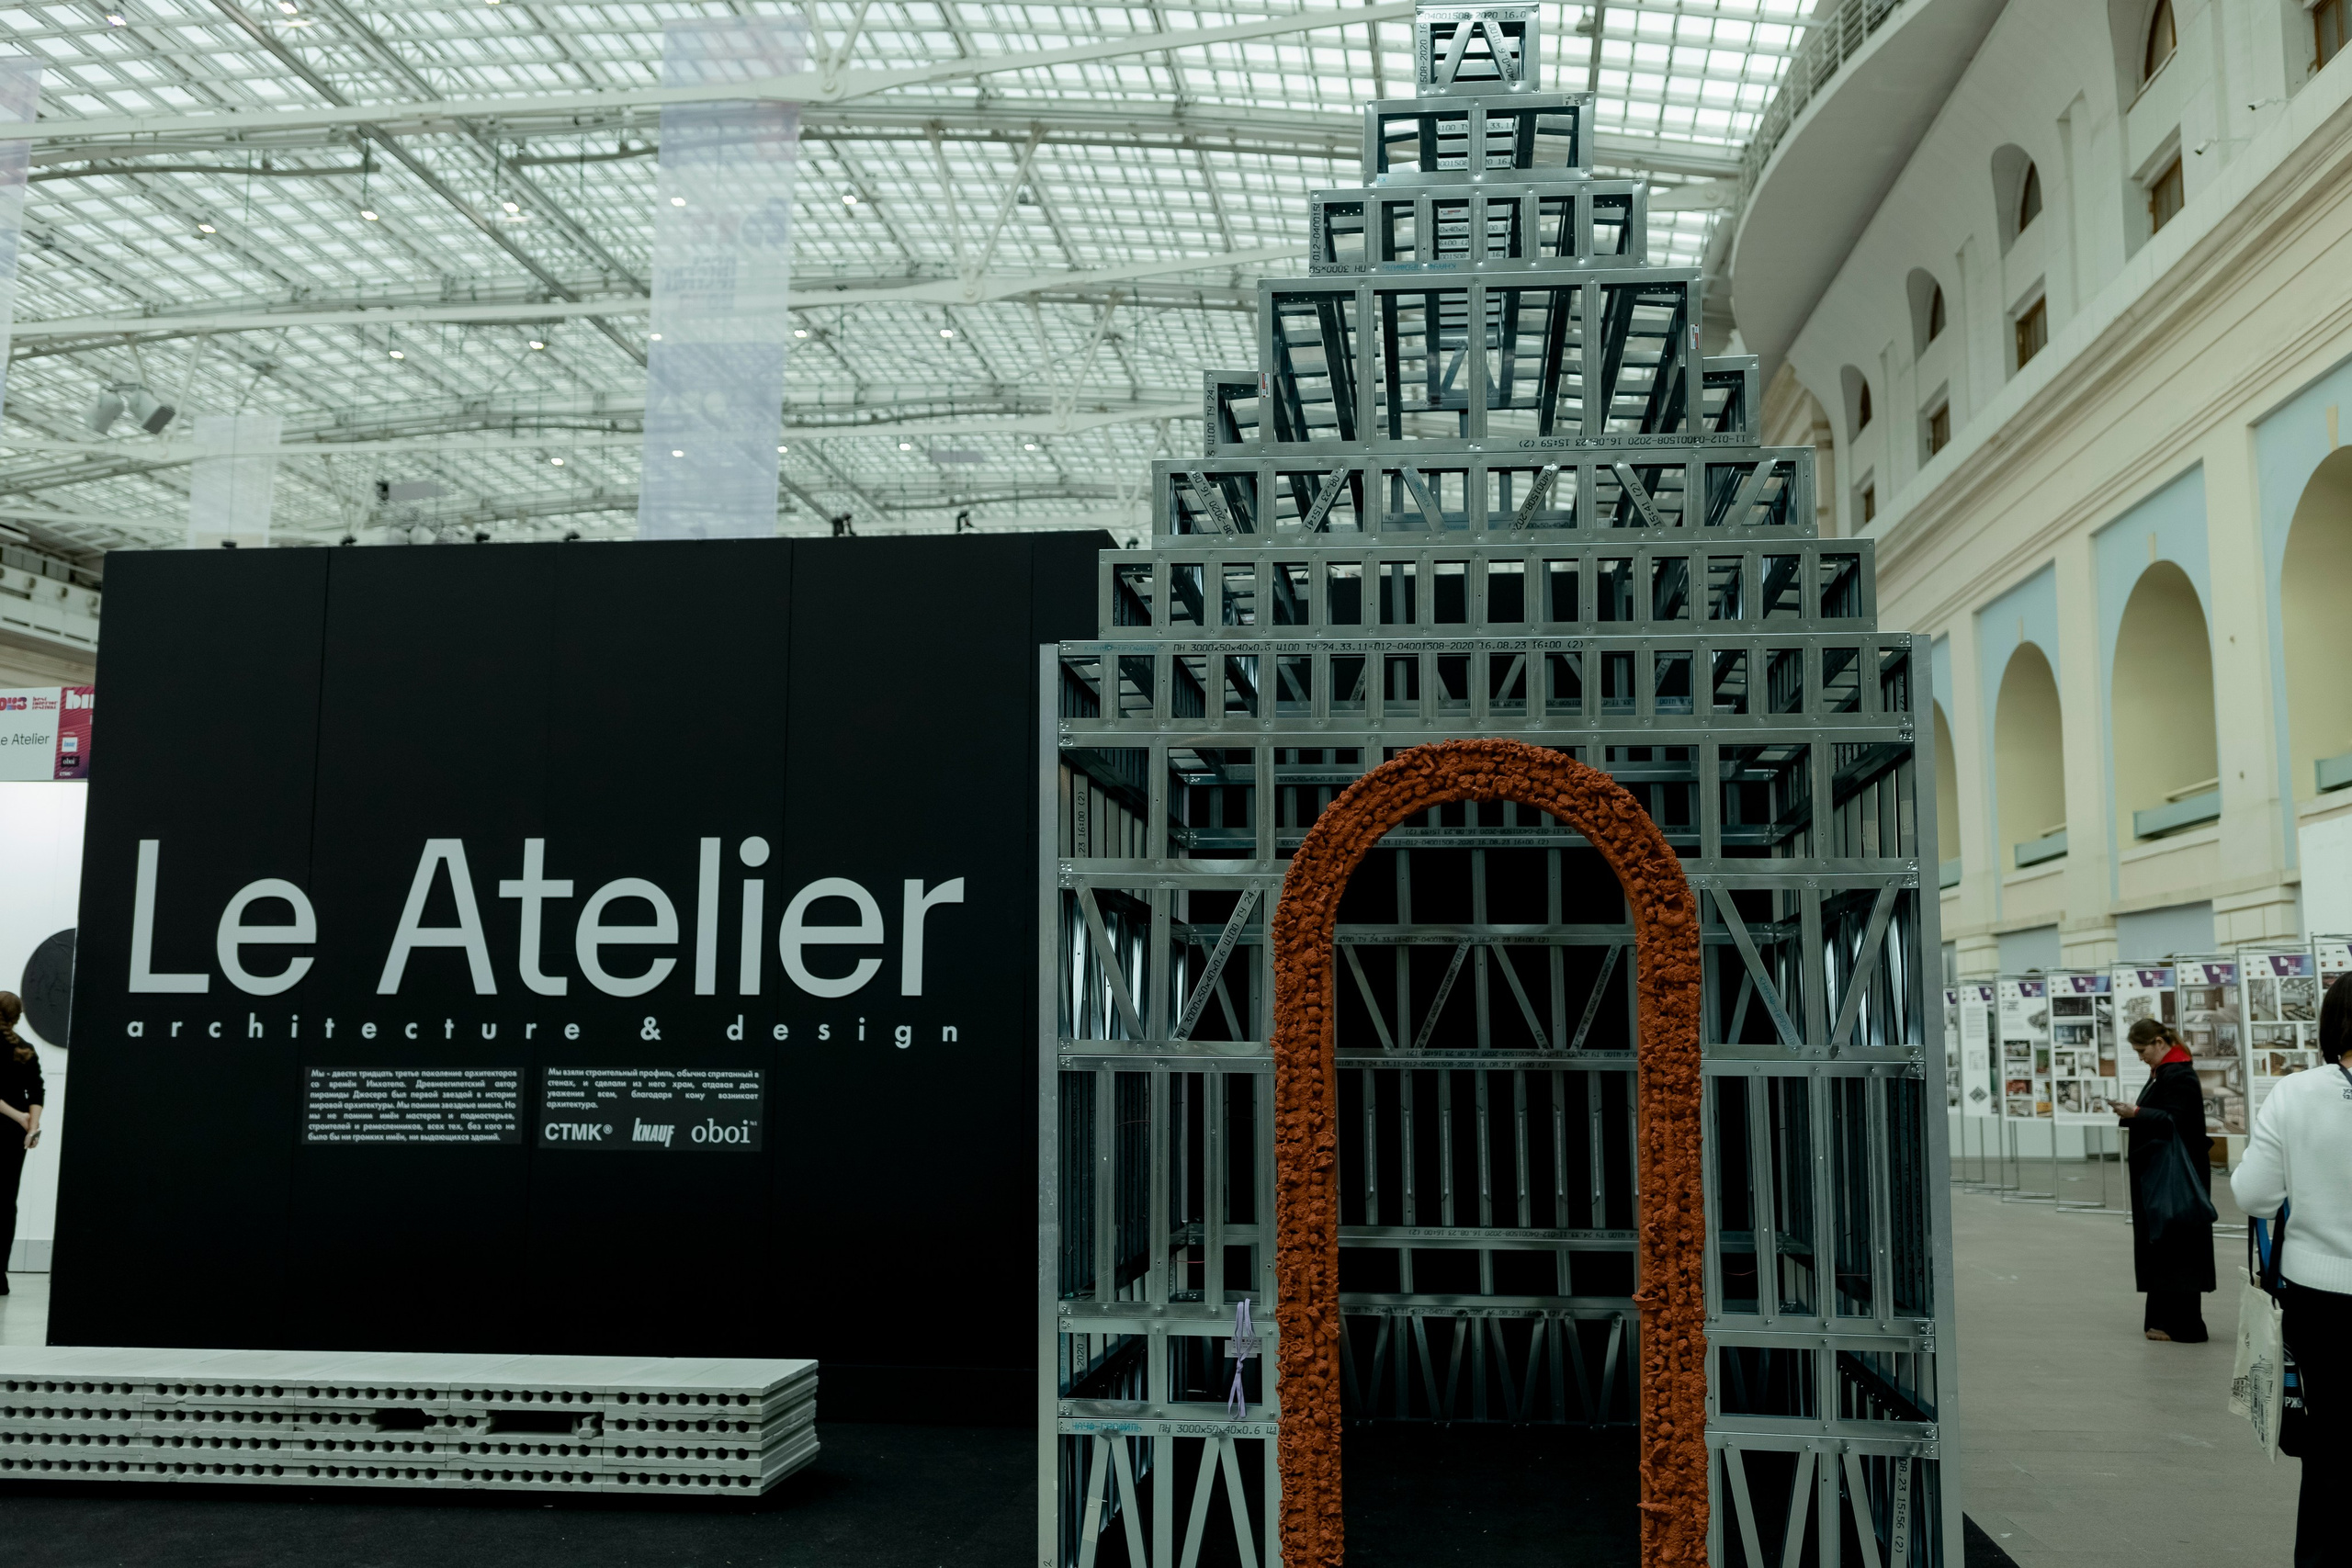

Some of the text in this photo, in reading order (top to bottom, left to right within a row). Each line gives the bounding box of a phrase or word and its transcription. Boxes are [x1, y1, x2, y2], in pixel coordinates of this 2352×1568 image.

[1520, 439, 1534, 447] (2)
[1541, 438, 1569, 447] 15:59
[1630, 482, 1643, 498] (2)
[1479, 641, 1527, 649] 16.08.23
[1532, 640, 1561, 649] 16:00
[1566, 640, 1584, 649] (2)
[11, 733, 50, 745] Atelier
[1078, 791, 1086, 806] (2)
[1078, 811, 1086, 837] 16:00
[129, 836, 964, 998] Le Atelier
[128, 1012, 956, 1048] architecture & design
[329, 1133, 340, 1141] бы
[691, 1118, 751, 1144] oboi
[1896, 1498, 1905, 1529] 15:56
[1895, 1536, 1905, 1553] (2)
